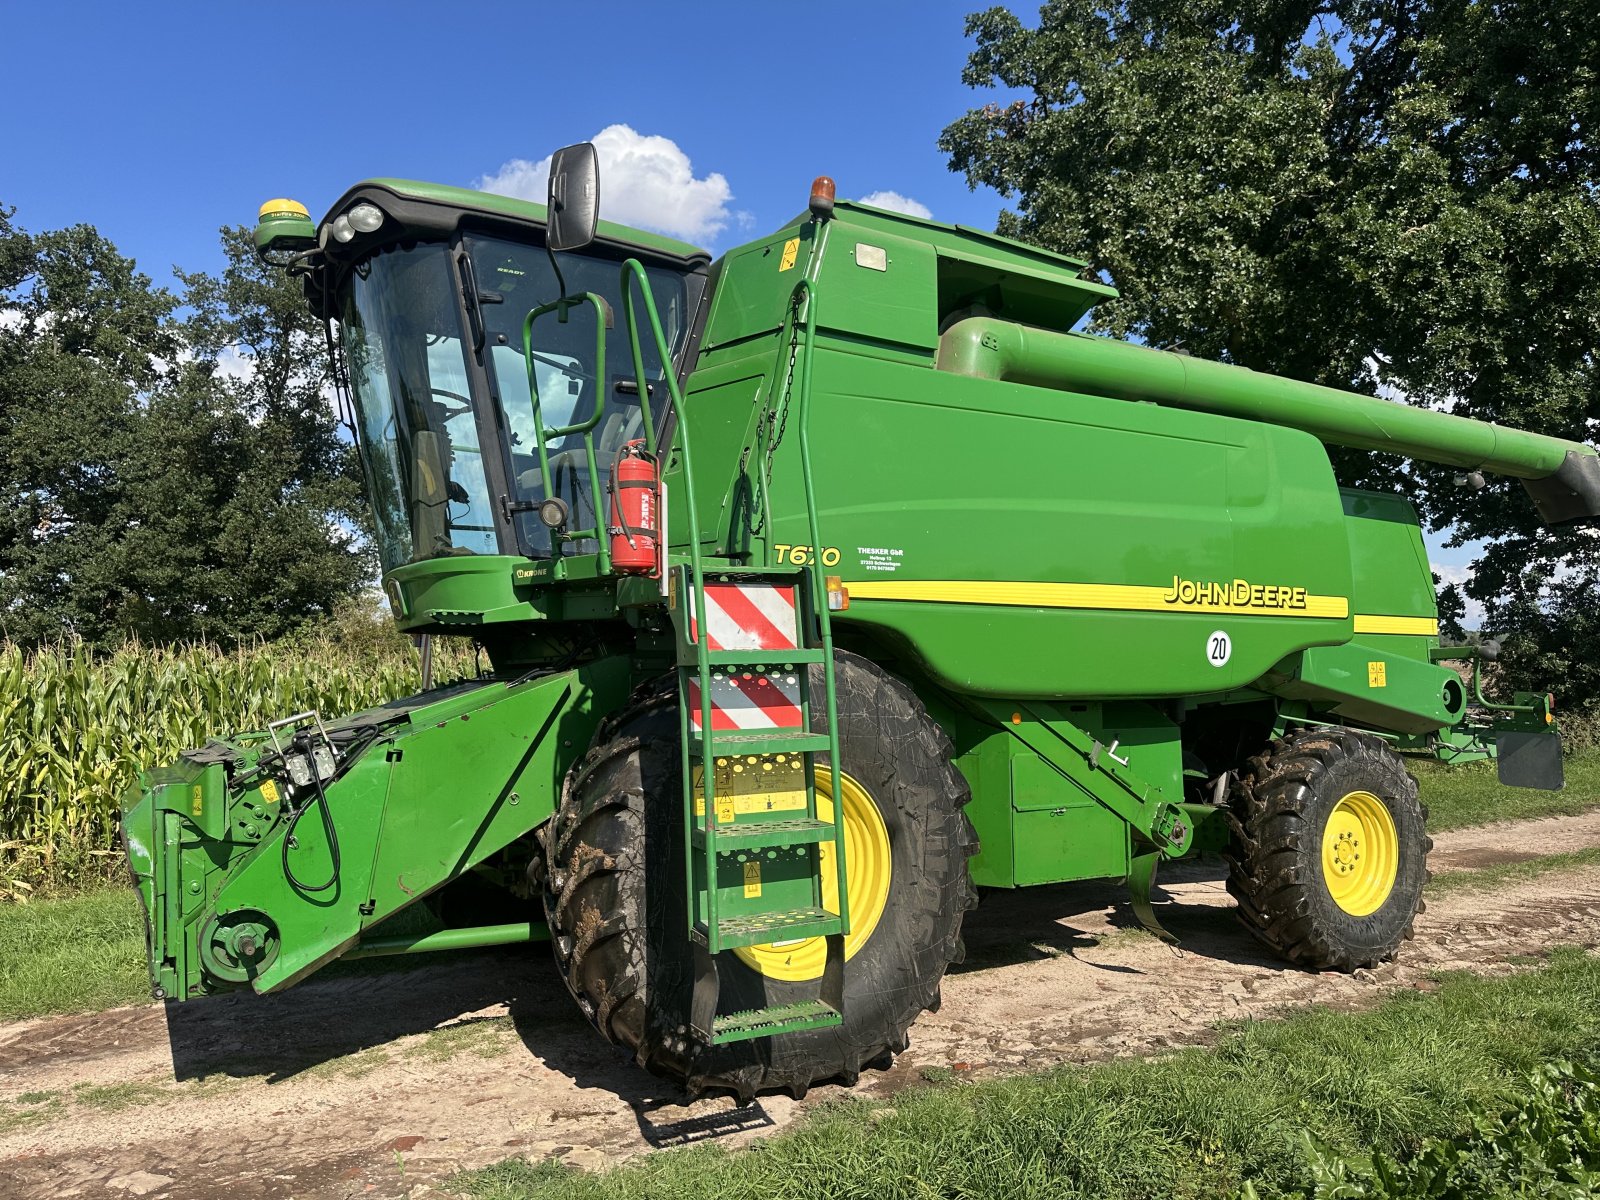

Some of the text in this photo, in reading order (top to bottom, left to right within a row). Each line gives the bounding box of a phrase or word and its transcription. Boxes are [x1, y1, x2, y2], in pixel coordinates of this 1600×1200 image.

[497, 267, 525, 276] READY
[857, 547, 889, 555] THESKER
[524, 569, 547, 577] KRONE
[1164, 575, 1307, 609] JOHN DEERE
[1211, 637, 1227, 660] 20
